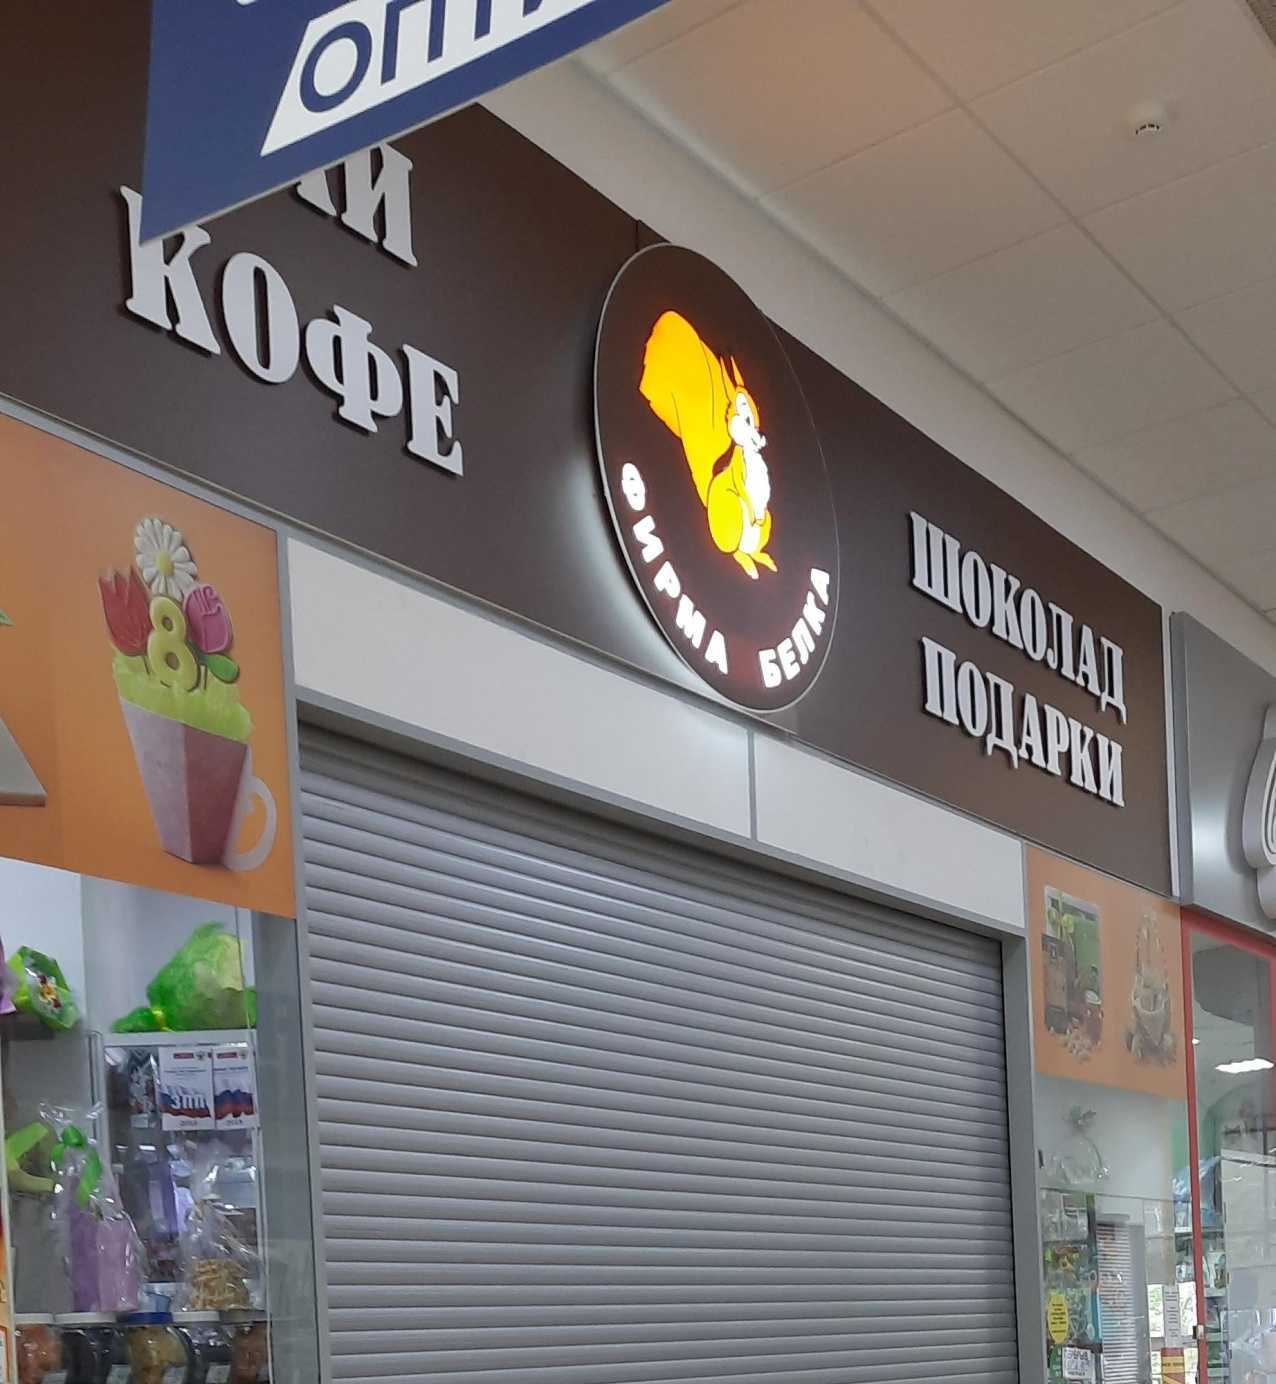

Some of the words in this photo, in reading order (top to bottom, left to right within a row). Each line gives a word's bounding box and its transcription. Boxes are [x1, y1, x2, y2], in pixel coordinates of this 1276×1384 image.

[120, 185, 464, 477] КОФЕ
[147, 595, 200, 692] 8
[620, 462, 728, 675] ФИРМА
[759, 567, 830, 688] БЕЛКА
[909, 511, 1127, 724] ШОКОЛАД
[921, 636, 1125, 806] ПОДАРКИ
